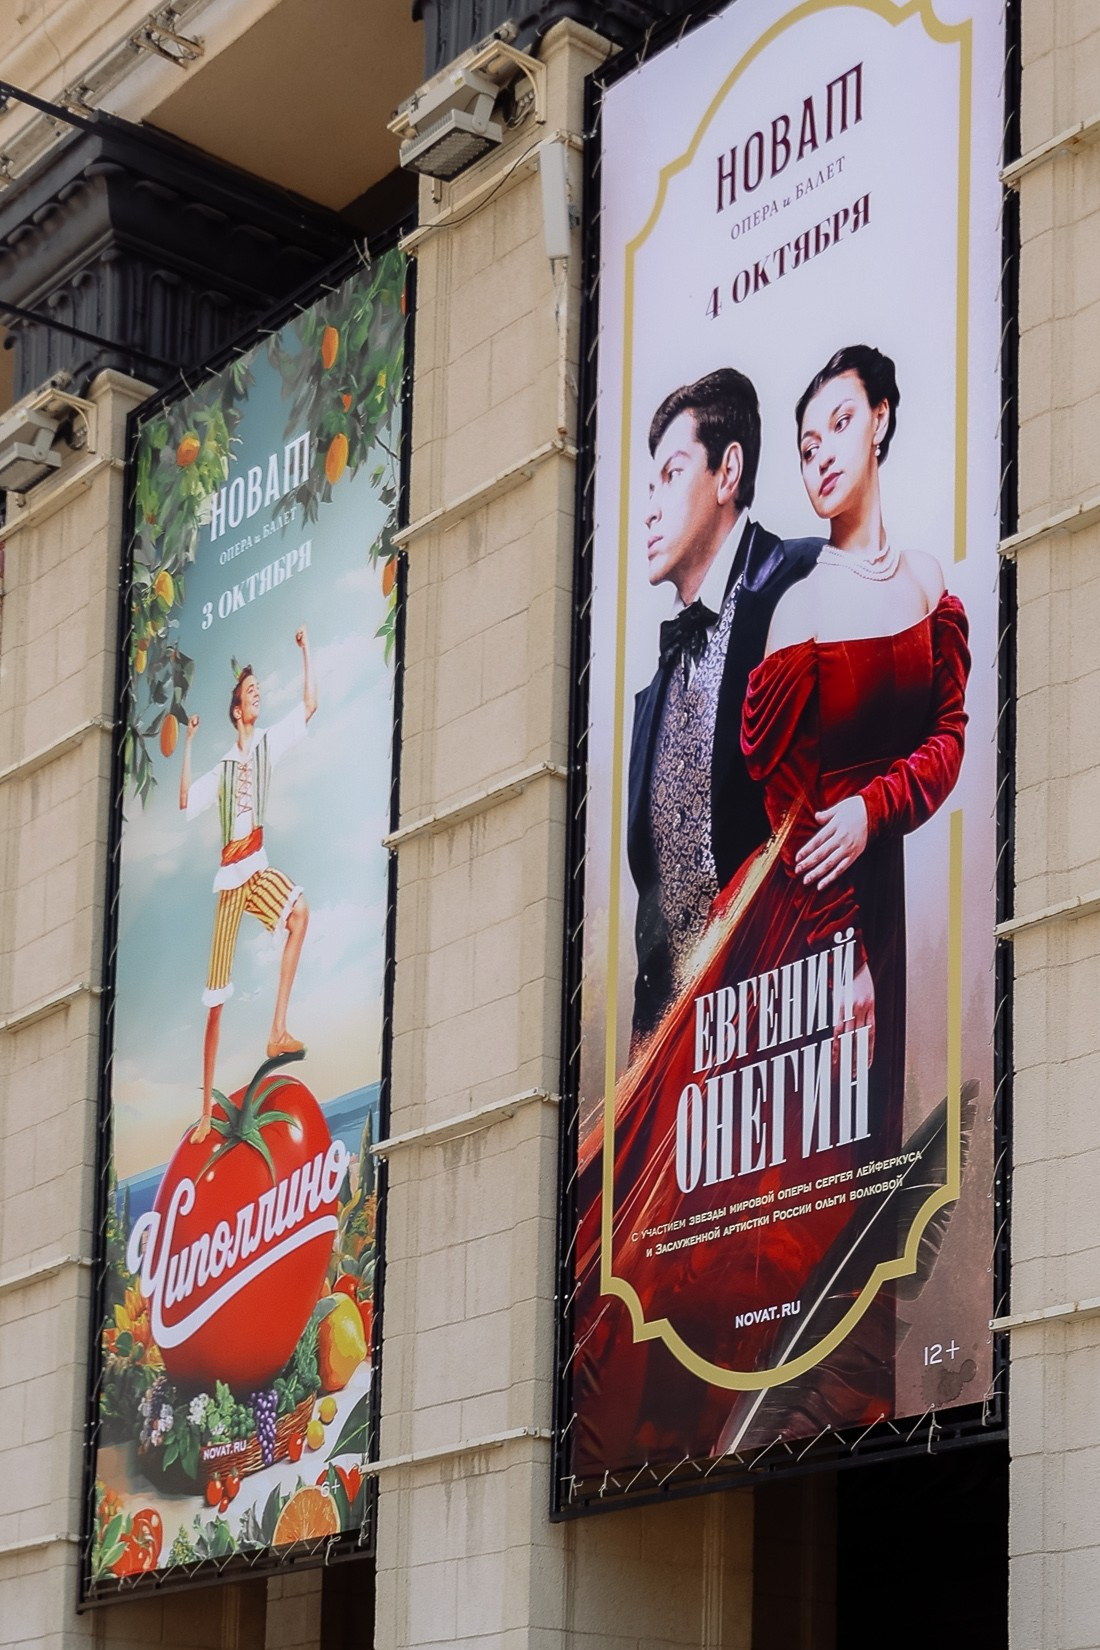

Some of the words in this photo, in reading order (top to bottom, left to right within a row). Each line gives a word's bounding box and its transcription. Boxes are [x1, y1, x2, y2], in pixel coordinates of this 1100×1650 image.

[716, 61, 863, 214] НОВАТ
[730, 200, 779, 240] ОПЕРА
[795, 156, 846, 200] БАЛЕТ
[705, 286, 722, 320] 4
[732, 191, 872, 304] ОКТЯБРЯ
[219, 535, 253, 566] ОПЕРА
[262, 506, 297, 539] БАЛЕТ
[201, 601, 213, 631] 3
[218, 539, 313, 619] ОКТЯБРЯ
[693, 927, 857, 1073] ЕВГЕНИЙ
[674, 1025, 872, 1194] ОНЕГИН
[631, 1232, 639, 1242] С
[641, 1218, 686, 1239] УЧАСТИЕМ
[688, 1207, 727, 1226] ЗВЕЗДЫ
[729, 1191, 775, 1215] МИРОВОЙ
[777, 1182, 812, 1200] ОПЕРЫ
[815, 1170, 854, 1189] СЕРГЕЯ
[856, 1150, 923, 1178] ЛЕЙФЕРКУСА
[655, 1226, 721, 1256] ЗАСЛУЖЕННОЙ
[722, 1214, 769, 1236] АРТИСТКИ
[773, 1203, 812, 1223] РОССИИ
[815, 1192, 846, 1211] ОЛЬГИ
[849, 1174, 904, 1201] ВОЛКОВОЙ
[126, 1139, 350, 1348] Чиполлино
[735, 1300, 801, 1329] NOVAT.RU
[924, 1339, 960, 1366] 12+
[202, 1439, 248, 1462] NOVAT.RU
[320, 1479, 341, 1498] 6+
